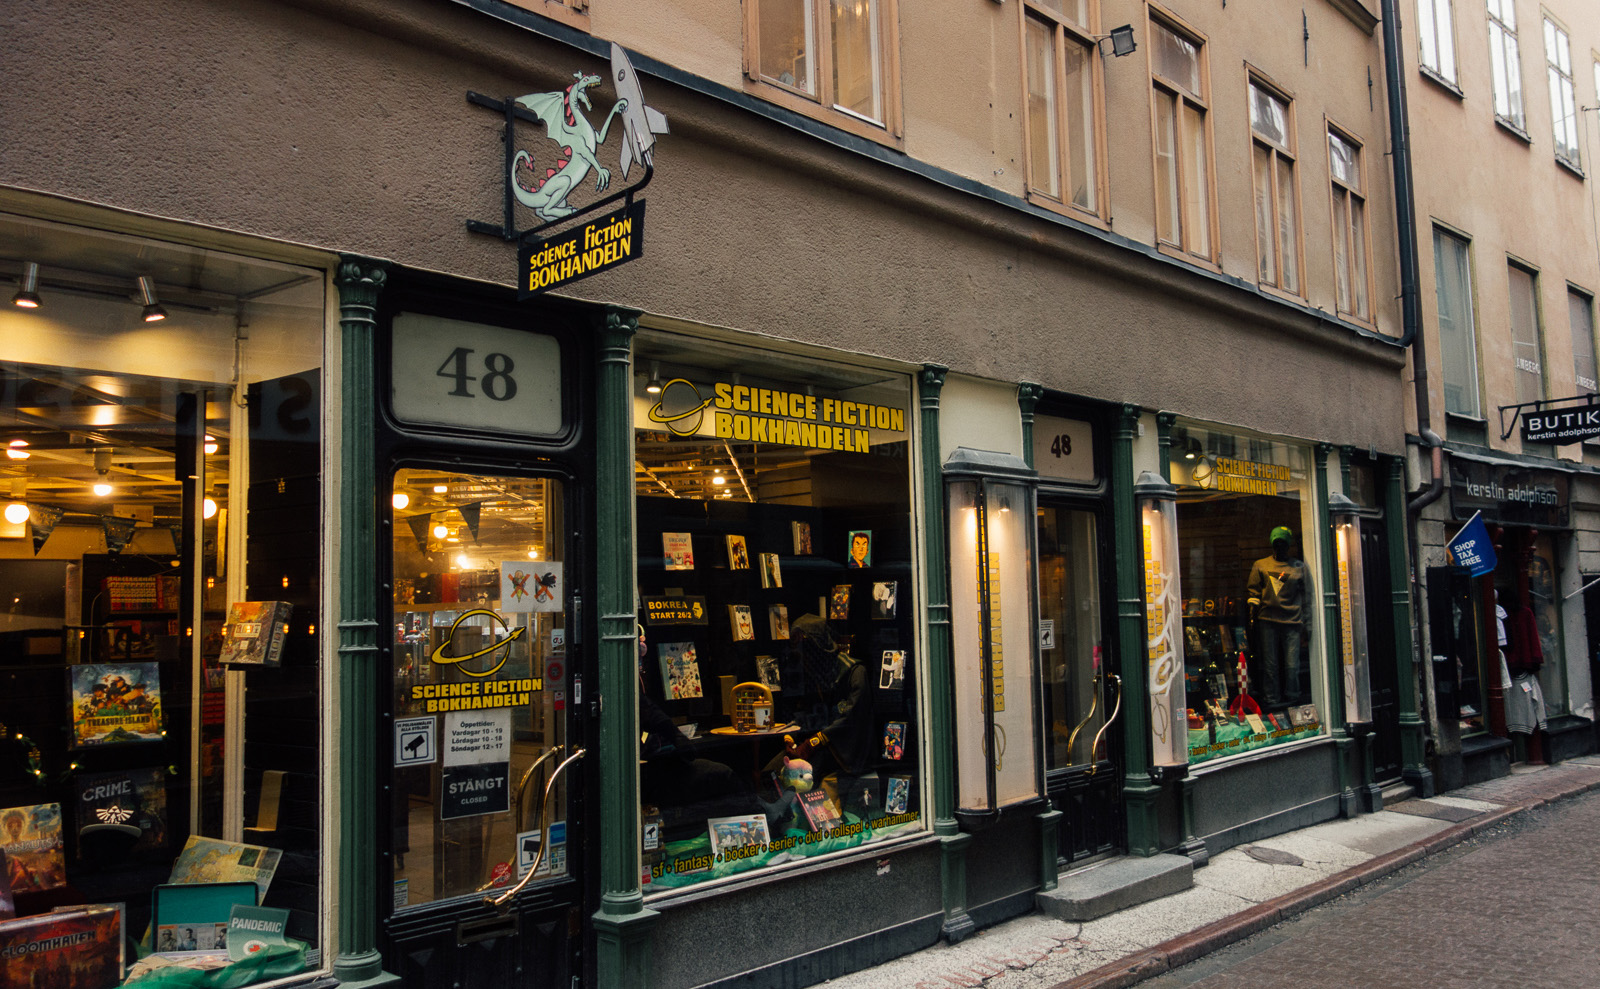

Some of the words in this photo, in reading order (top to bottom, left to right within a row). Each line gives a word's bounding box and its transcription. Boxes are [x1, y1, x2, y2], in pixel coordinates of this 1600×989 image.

[529, 236, 631, 291] BOKHANDELN
[436, 347, 517, 401] 48
[714, 382, 816, 420] SCIENCE
[823, 398, 904, 432] FICTION
[1528, 410, 1600, 431] BUTIK
[714, 412, 870, 454] BOKHANDELN
[1528, 432, 1556, 440] kerstin
[1051, 434, 1072, 458] 48
[1216, 458, 1256, 476] SCIENCE
[1258, 464, 1290, 480] FICTION
[1218, 476, 1277, 496] BOKHANDELN
[1466, 477, 1504, 500] kerstin
[1508, 484, 1558, 508] adolphson
[1454, 540, 1476, 552] SHOP
[1457, 549, 1474, 560] TAX
[1460, 554, 1482, 566] FREE
[648, 601, 688, 610] BOKREA
[650, 612, 675, 620] START
[412, 682, 480, 699] SCIENCE
[484, 678, 542, 694] FICTION
[427, 692, 530, 713] BOKHANDELN
[87, 716, 124, 728] TREASURE
[126, 715, 150, 726] ISLAND
[82, 780, 132, 801] CRIME
[449, 777, 504, 794] STÄNGT
[461, 796, 488, 804] CLOSED
[652, 863, 664, 878] sf
[674, 854, 714, 873] fantasy
[724, 844, 760, 862] böcker
[769, 836, 796, 852] serier
[805, 830, 822, 844] dvd
[830, 823, 864, 840] rollspel
[871, 811, 918, 830] warhammer
[231, 917, 282, 933] PANDEMIC
